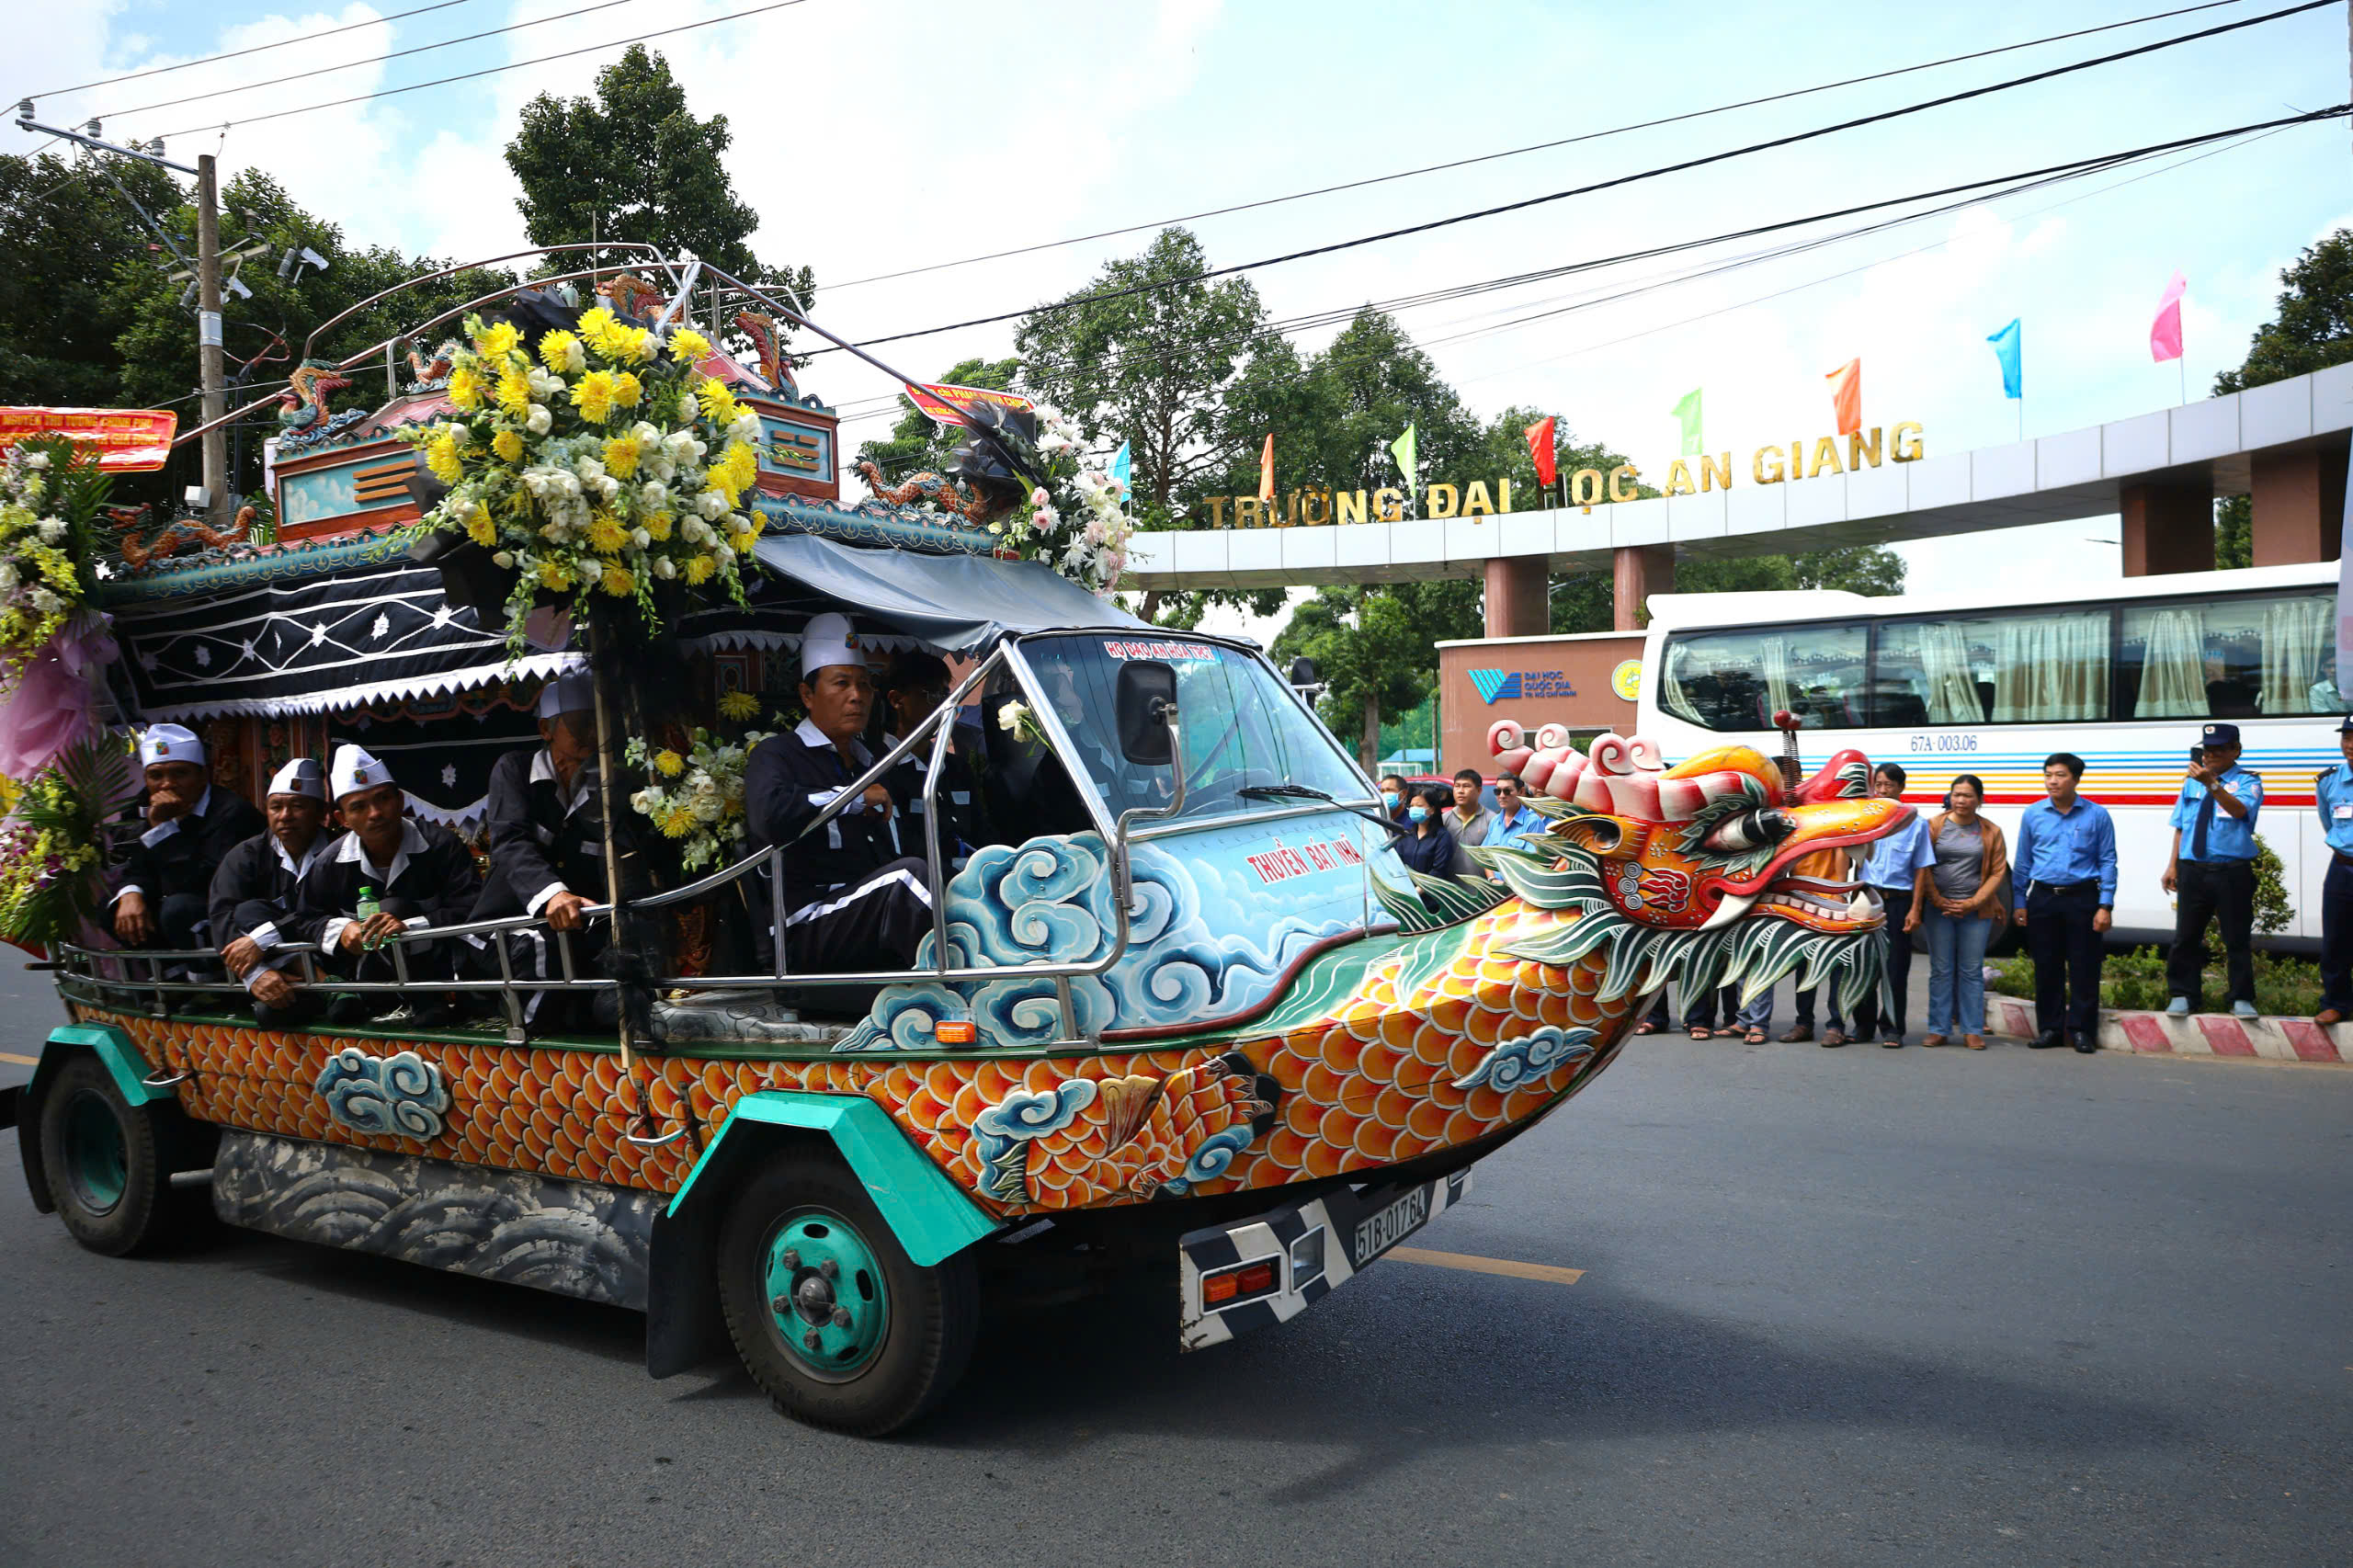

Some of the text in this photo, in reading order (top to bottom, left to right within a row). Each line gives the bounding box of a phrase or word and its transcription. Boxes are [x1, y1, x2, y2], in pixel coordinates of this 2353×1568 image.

[1203, 421, 1924, 529] TRƯỜNG ĐẠI HỌC AN GIANG
[1149, 642, 1171, 659] AN
[1245, 836, 1312, 883] THUYỀN
[1303, 836, 1339, 871] BÁT
